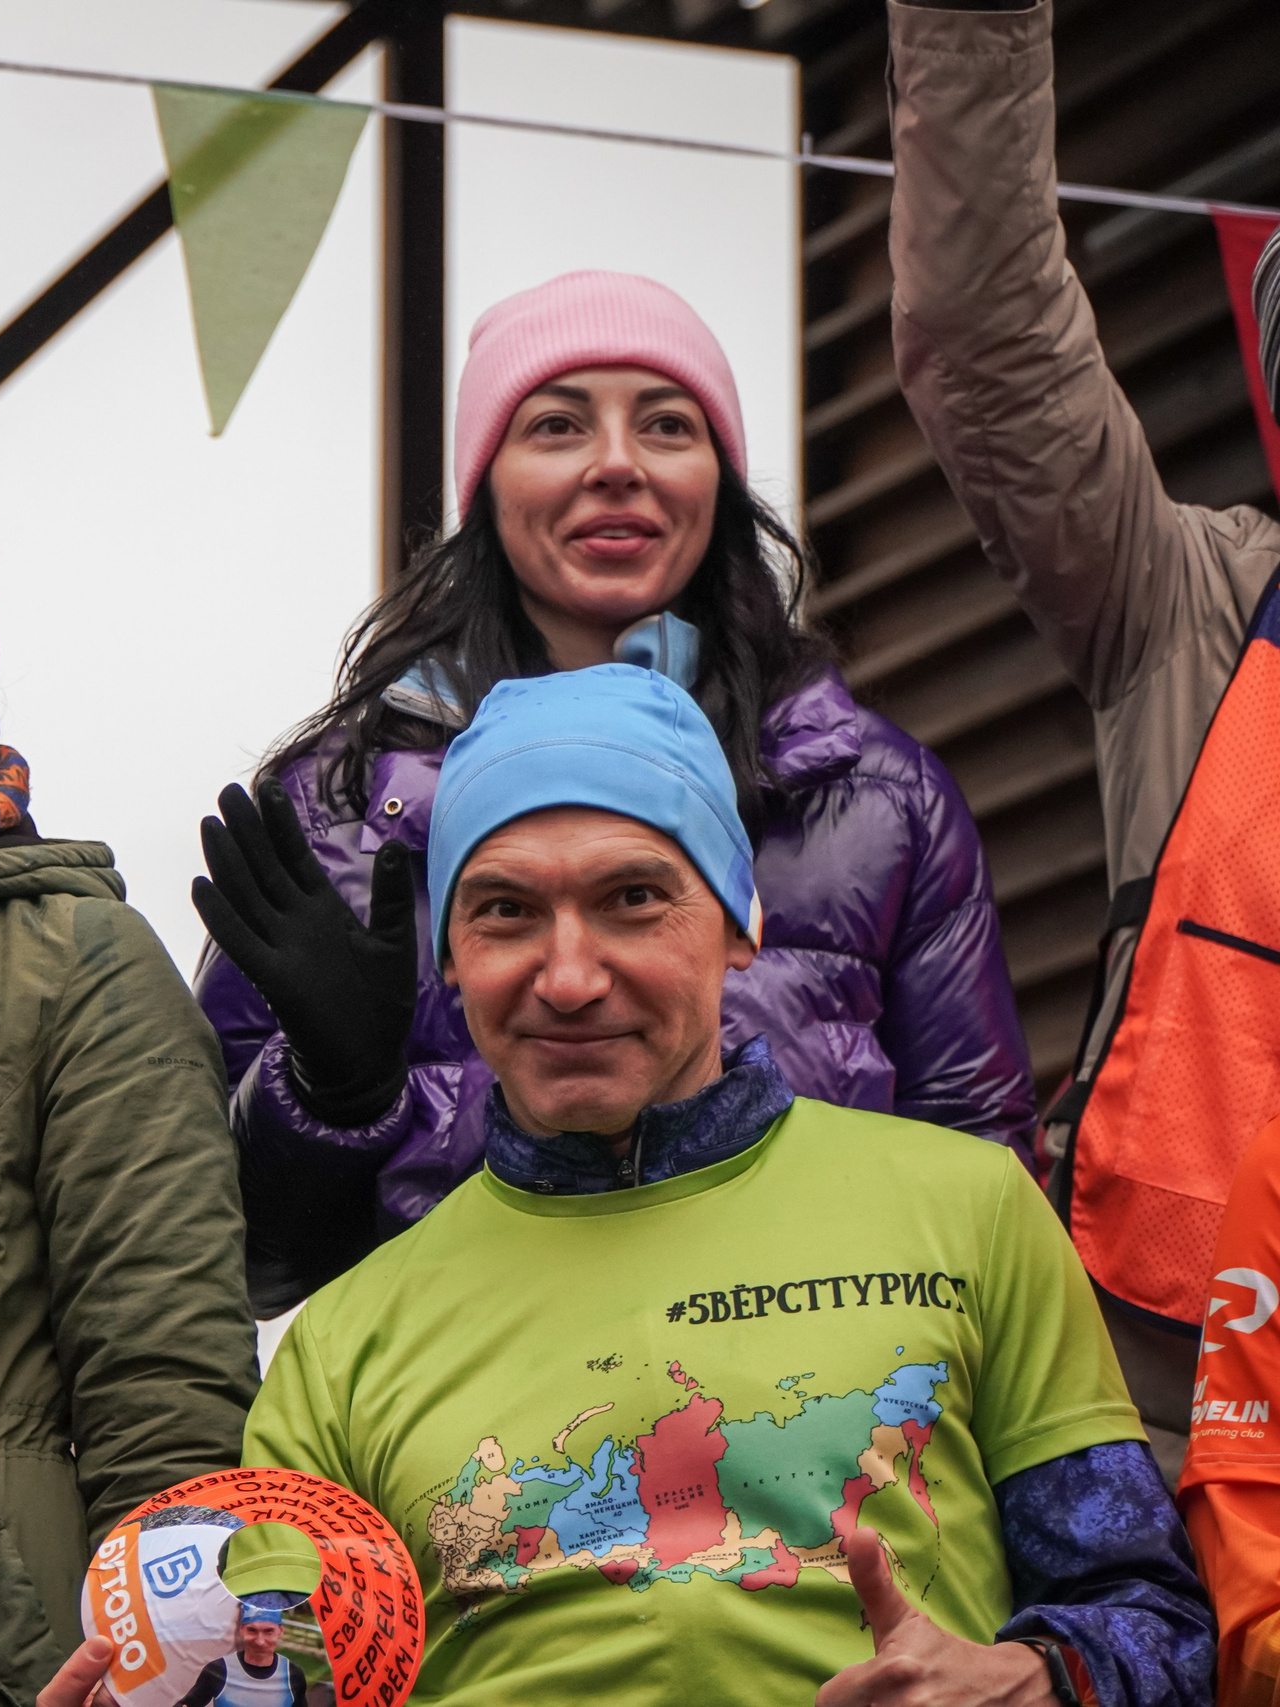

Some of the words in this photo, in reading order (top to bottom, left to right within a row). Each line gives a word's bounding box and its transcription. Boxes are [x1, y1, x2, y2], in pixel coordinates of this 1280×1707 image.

[666, 1272, 967, 1325] #5ВЁРСТТУРИСТ
[883, 1397, 929, 1411] ЧУКОТСКИЙ
[1240, 1428, 1265, 1439] club
[517, 1498, 548, 1512] КОМИ
[594, 1499, 639, 1514] НЕНЕЦКИЙ
[568, 1531, 625, 1550] МАНСИЙСКИЙ
[579, 1528, 611, 1540] ХАНТЫ-
[98, 1534, 148, 1673] БУТОВО
